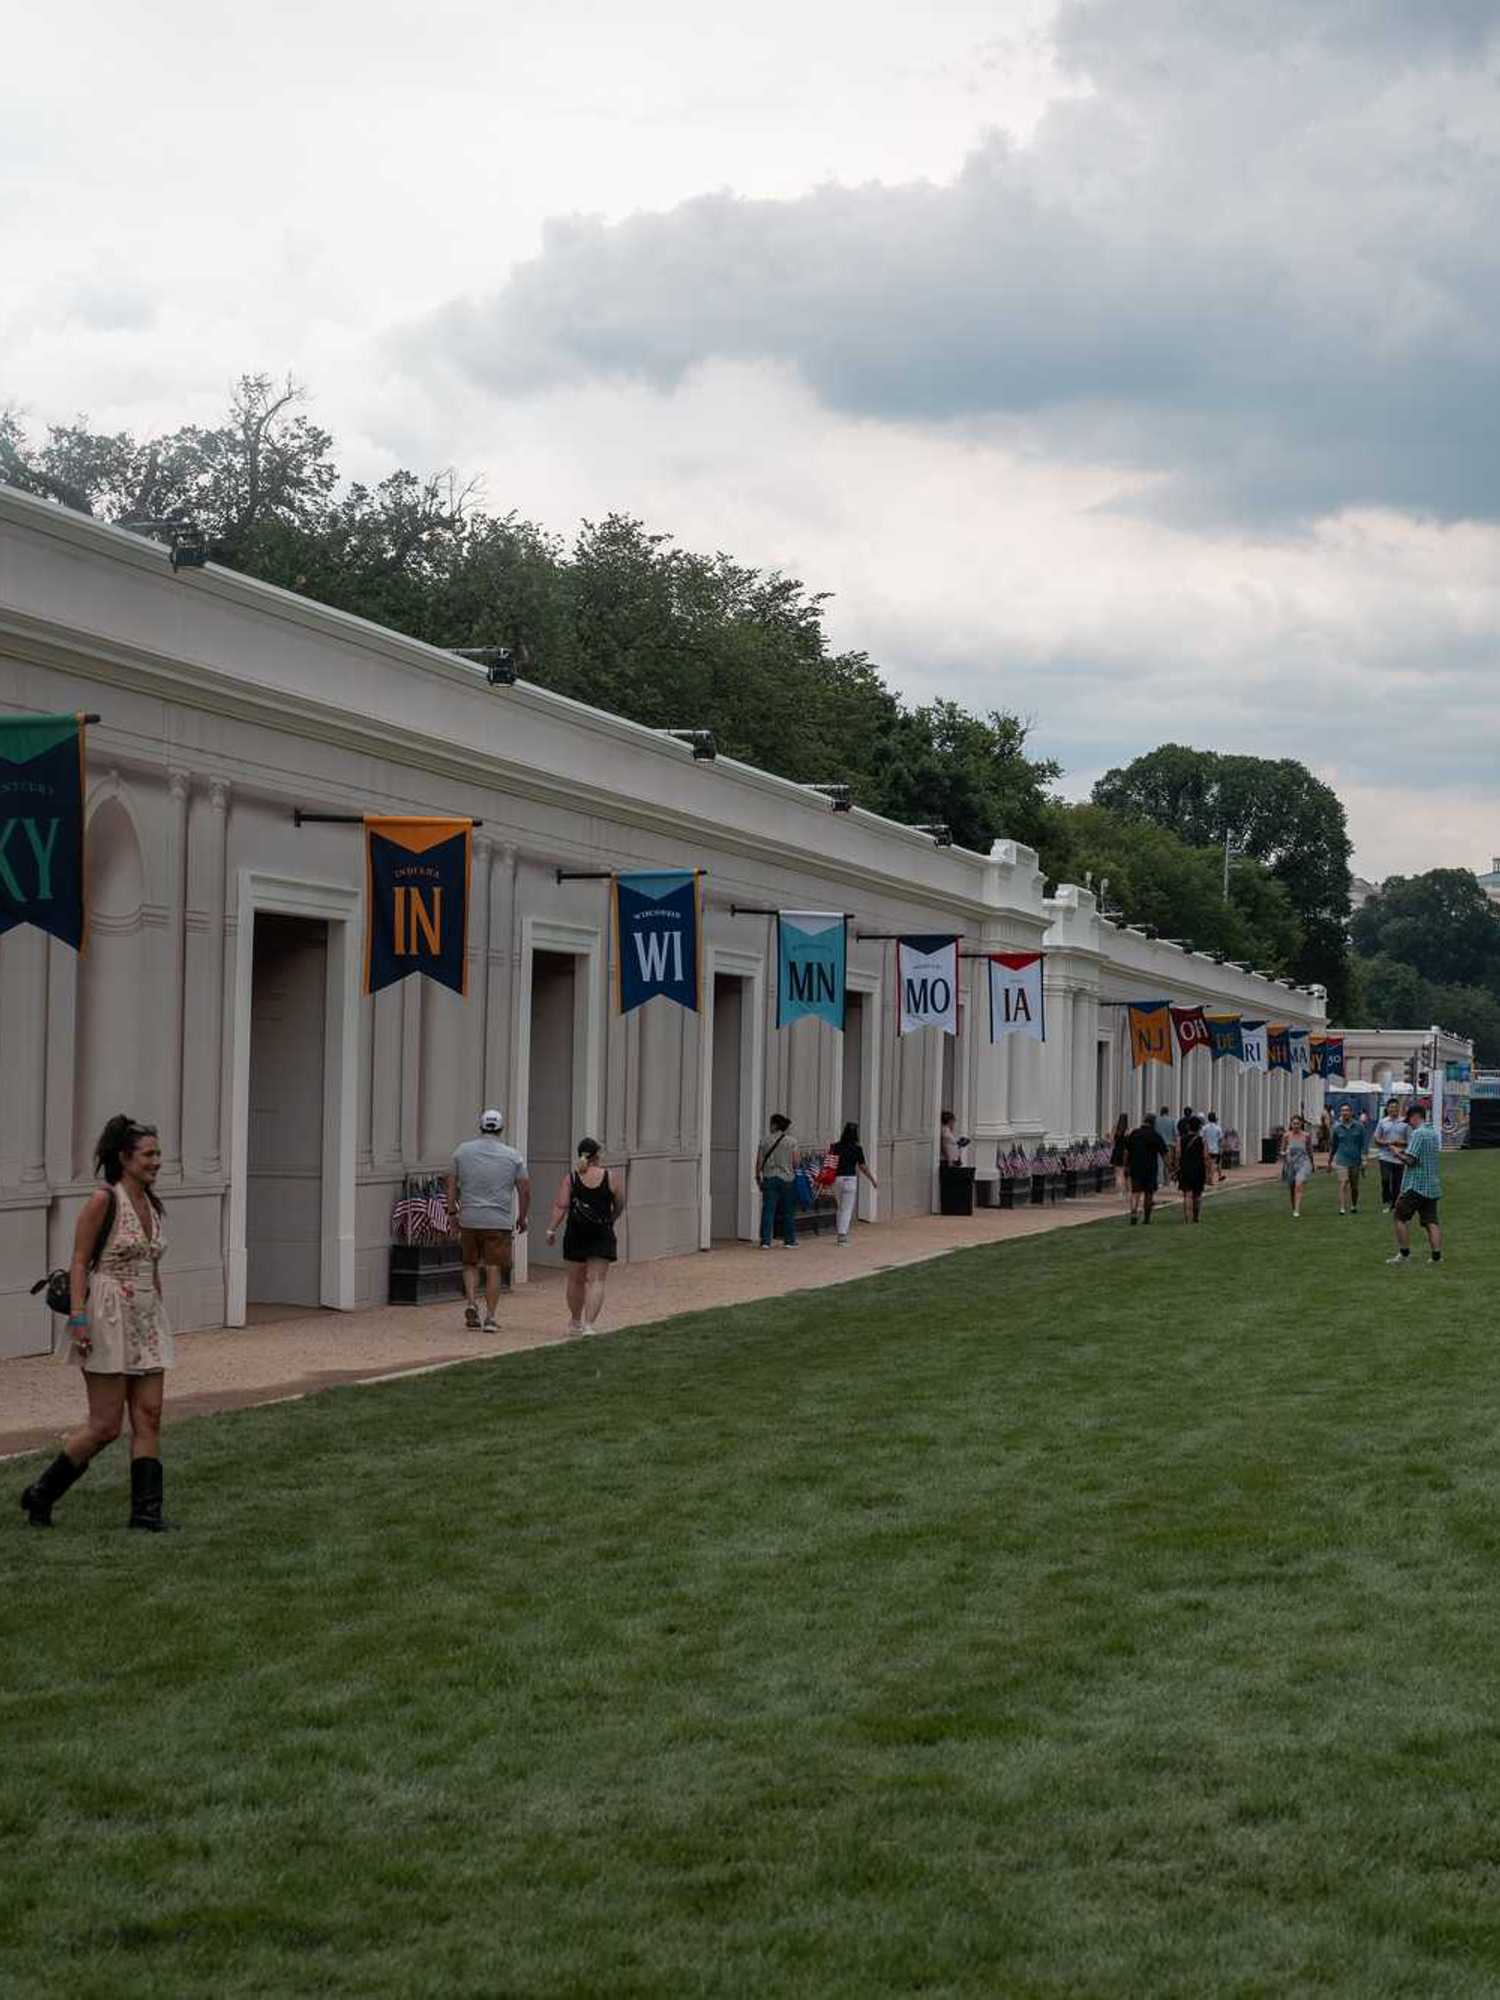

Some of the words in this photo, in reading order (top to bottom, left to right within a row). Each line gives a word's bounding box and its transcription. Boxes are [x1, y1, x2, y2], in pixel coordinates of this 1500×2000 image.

[392, 886, 444, 956] IN
[633, 931, 684, 982] WI
[789, 960, 835, 1004] MN
[906, 978, 950, 1014] MO
[1004, 988, 1031, 1021] IA
[1138, 1030, 1163, 1051] NJ
[1181, 1020, 1208, 1041] OH
[1245, 1043, 1260, 1062] RI
